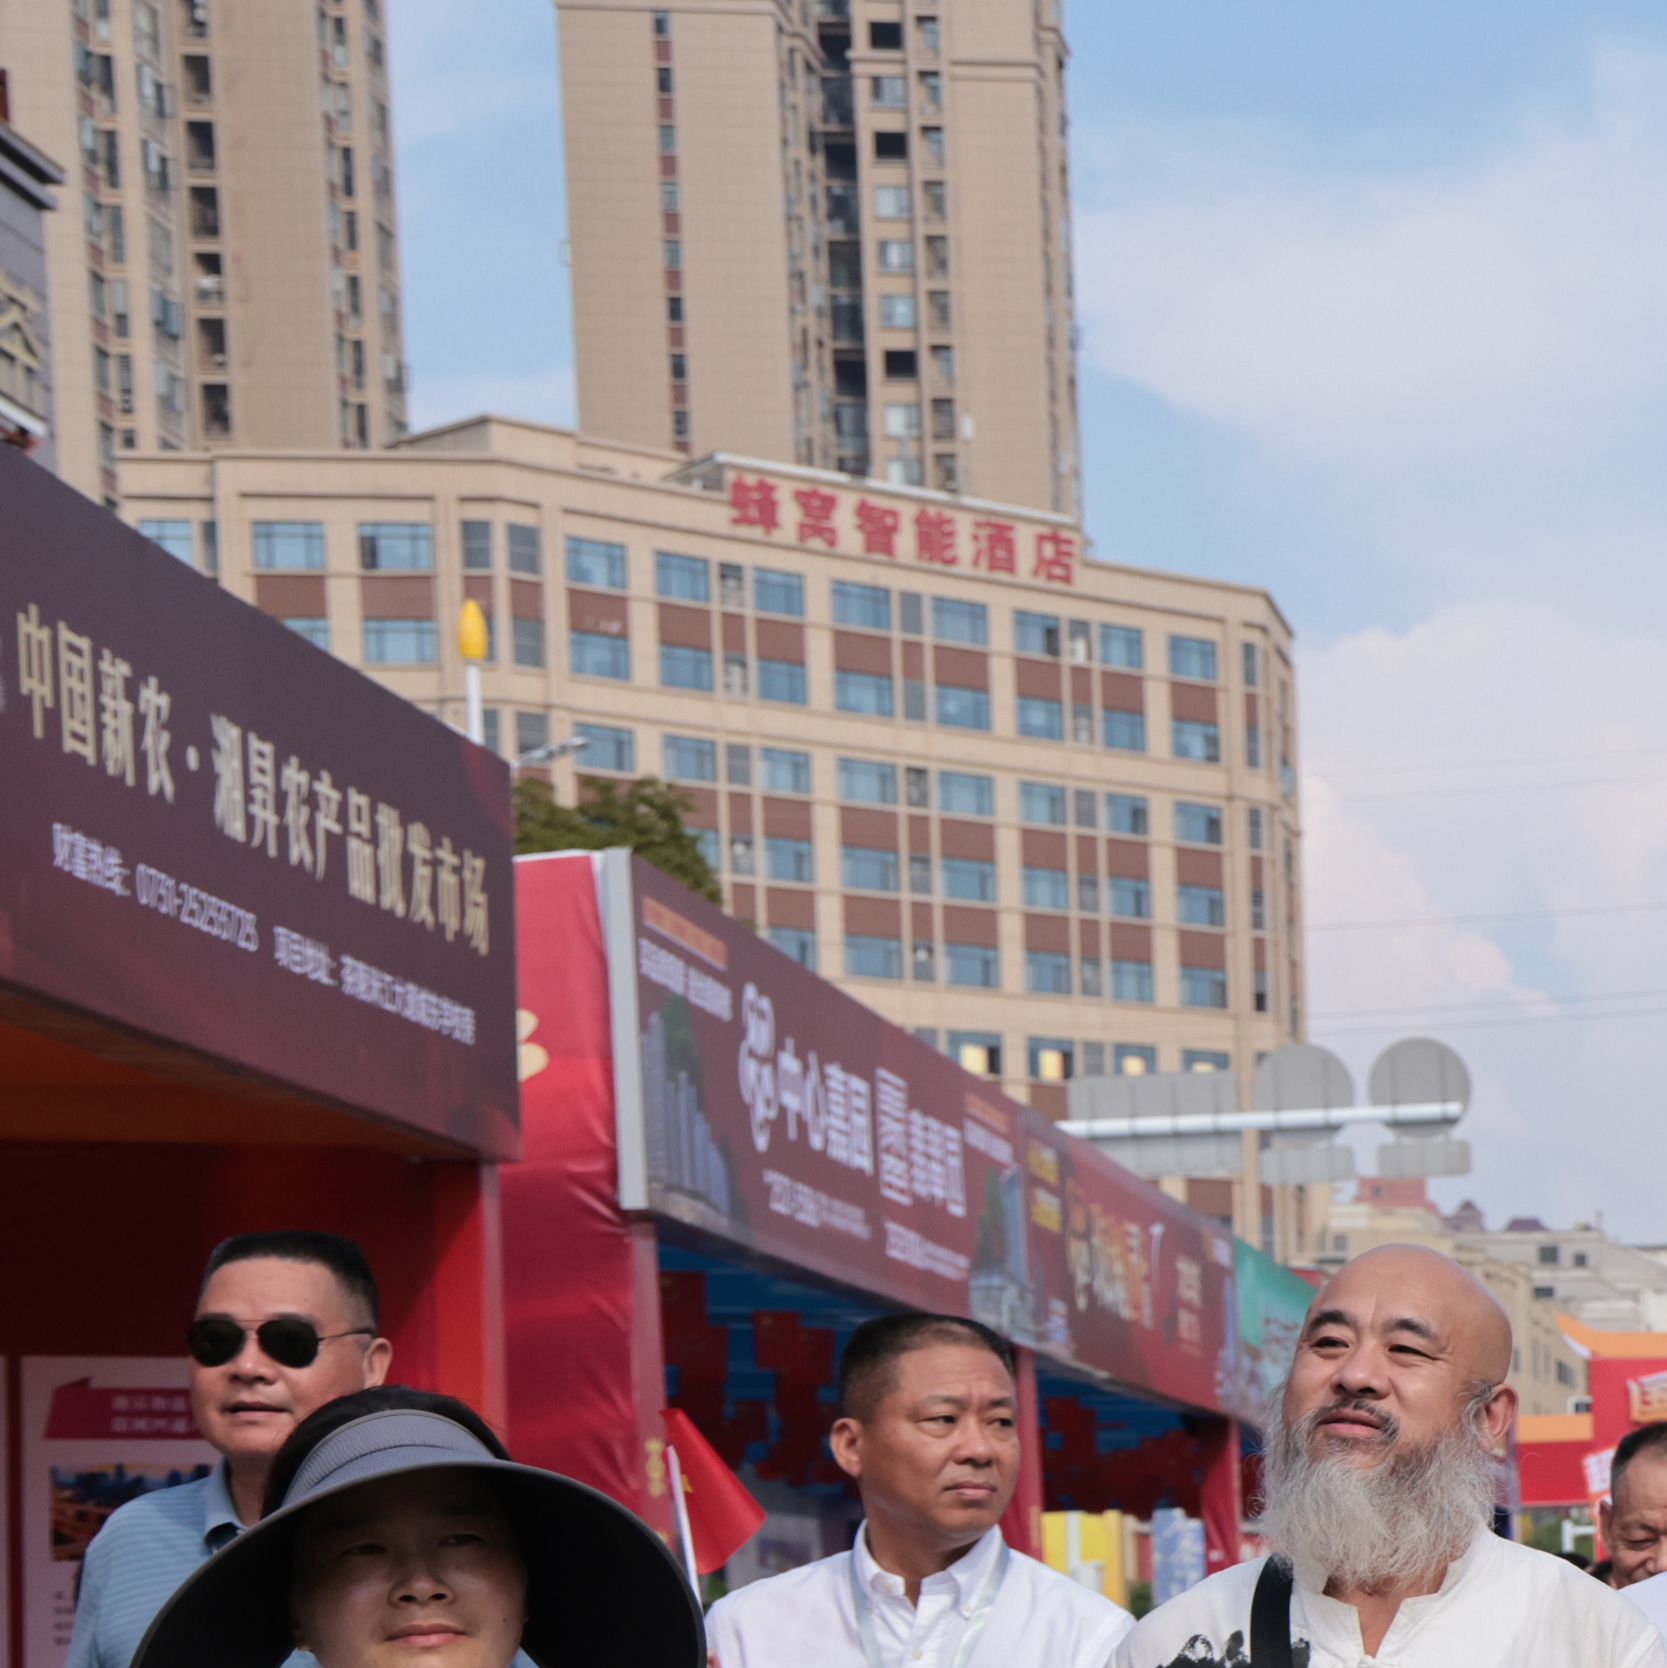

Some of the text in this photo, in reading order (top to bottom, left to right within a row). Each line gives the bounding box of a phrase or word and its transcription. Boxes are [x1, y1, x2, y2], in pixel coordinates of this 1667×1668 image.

[729, 474, 1076, 584] 蜂窝智能酒店
